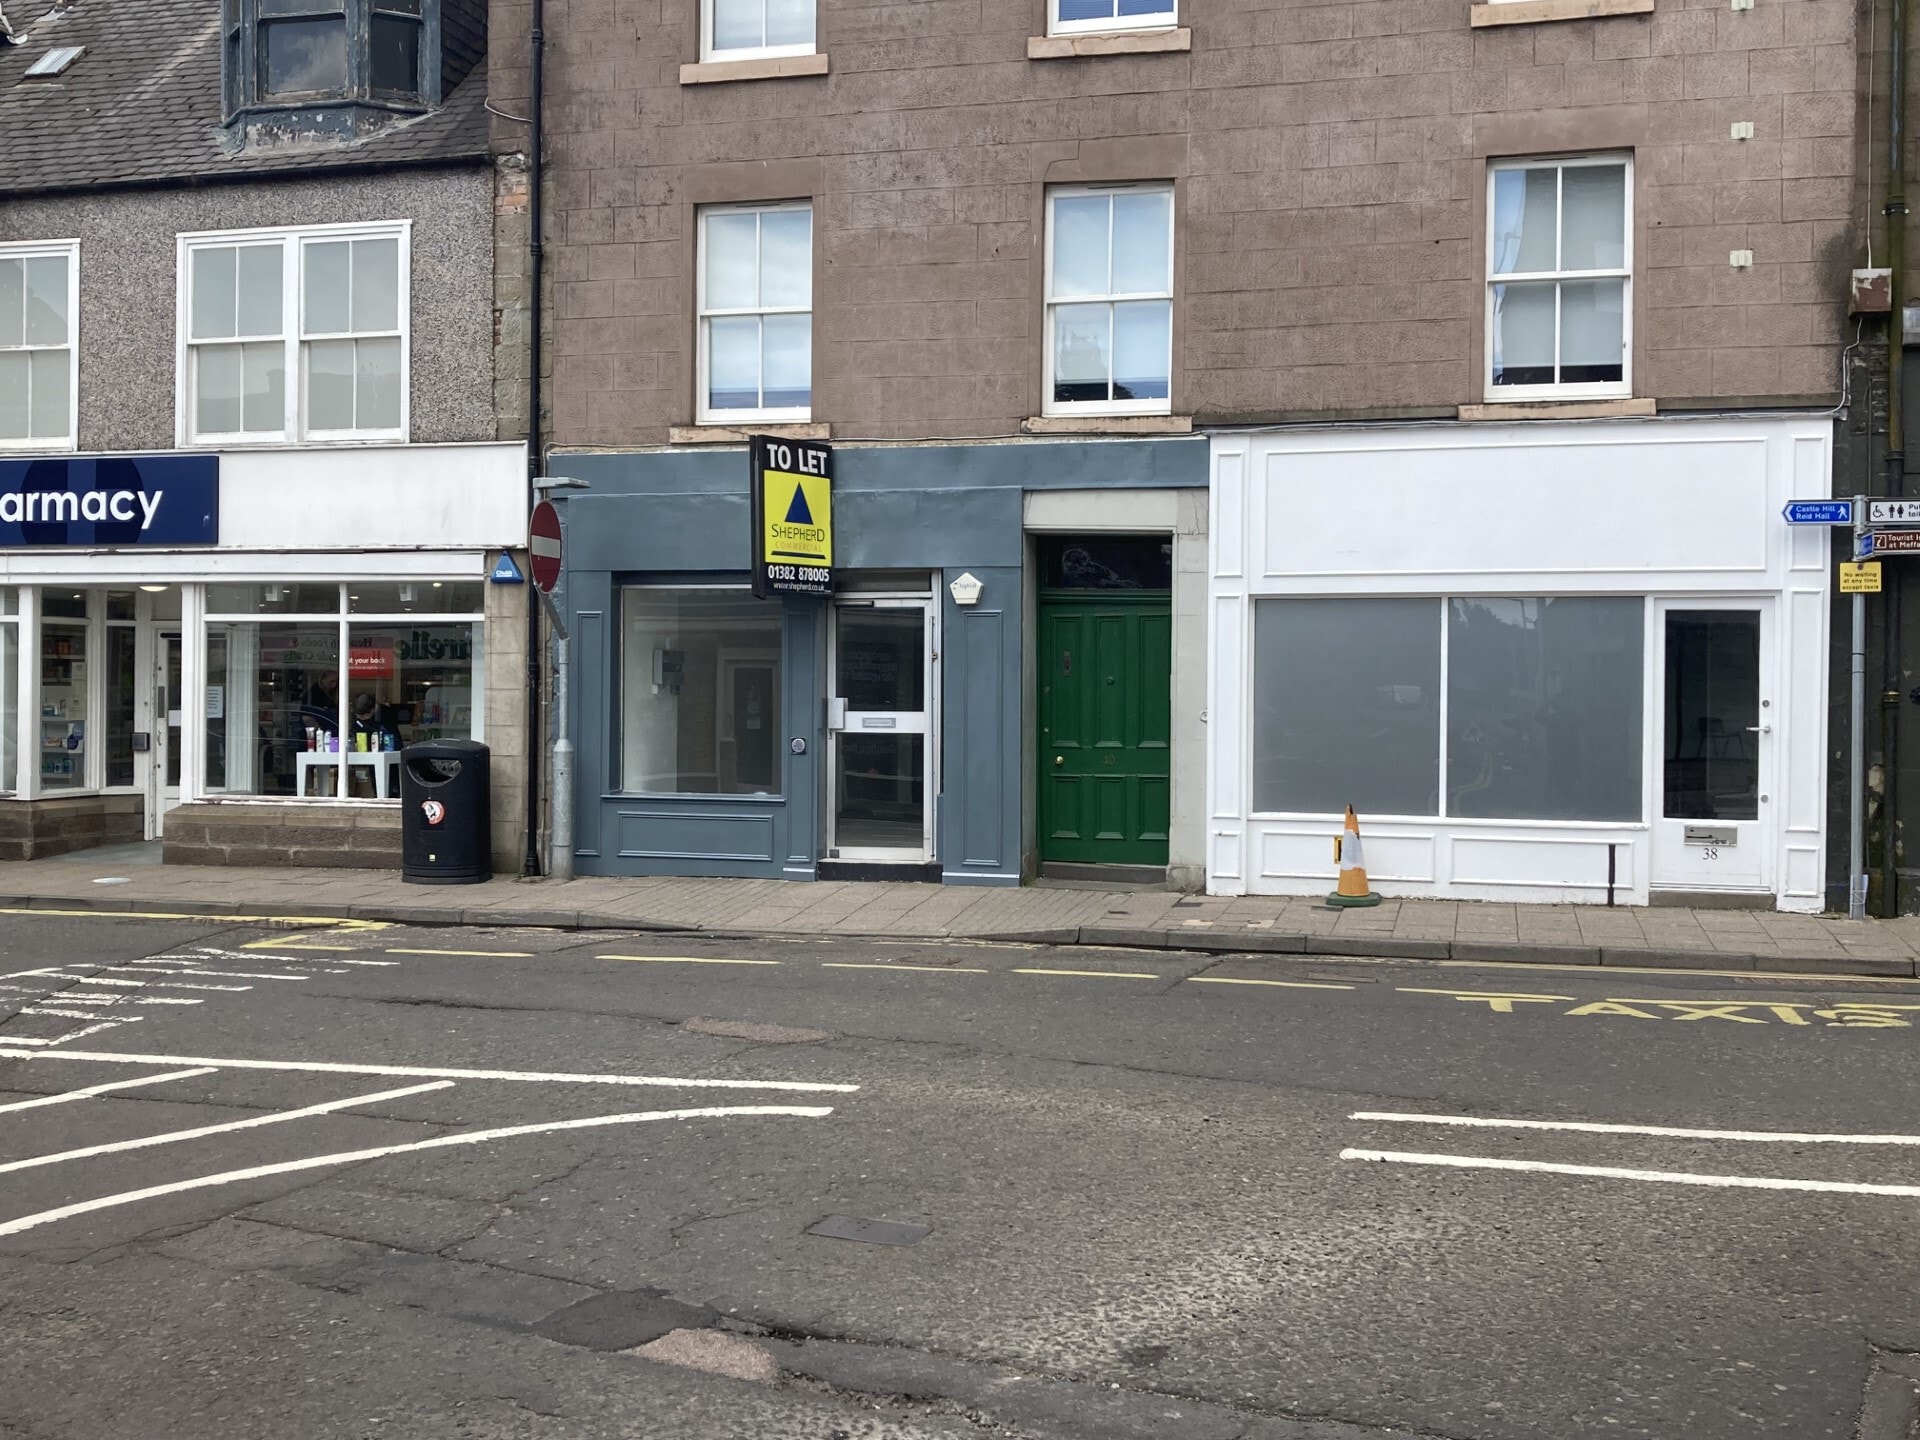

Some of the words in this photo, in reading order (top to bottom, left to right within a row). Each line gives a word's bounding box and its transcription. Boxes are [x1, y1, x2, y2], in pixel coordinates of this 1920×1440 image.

[766, 443, 791, 470] TO
[798, 448, 827, 475] LET
[0, 490, 163, 530] armacy
[1796, 505, 1820, 513] Castle
[771, 524, 825, 542] SHEPHERD
[774, 541, 822, 552] COMMERCIAL
[768, 564, 795, 580] 01382
[798, 567, 830, 582] 878005
[354, 657, 369, 665] your
[370, 656, 385, 664] back
[1702, 847, 1718, 860] 38
[1455, 996, 1911, 1028] TAXIS
